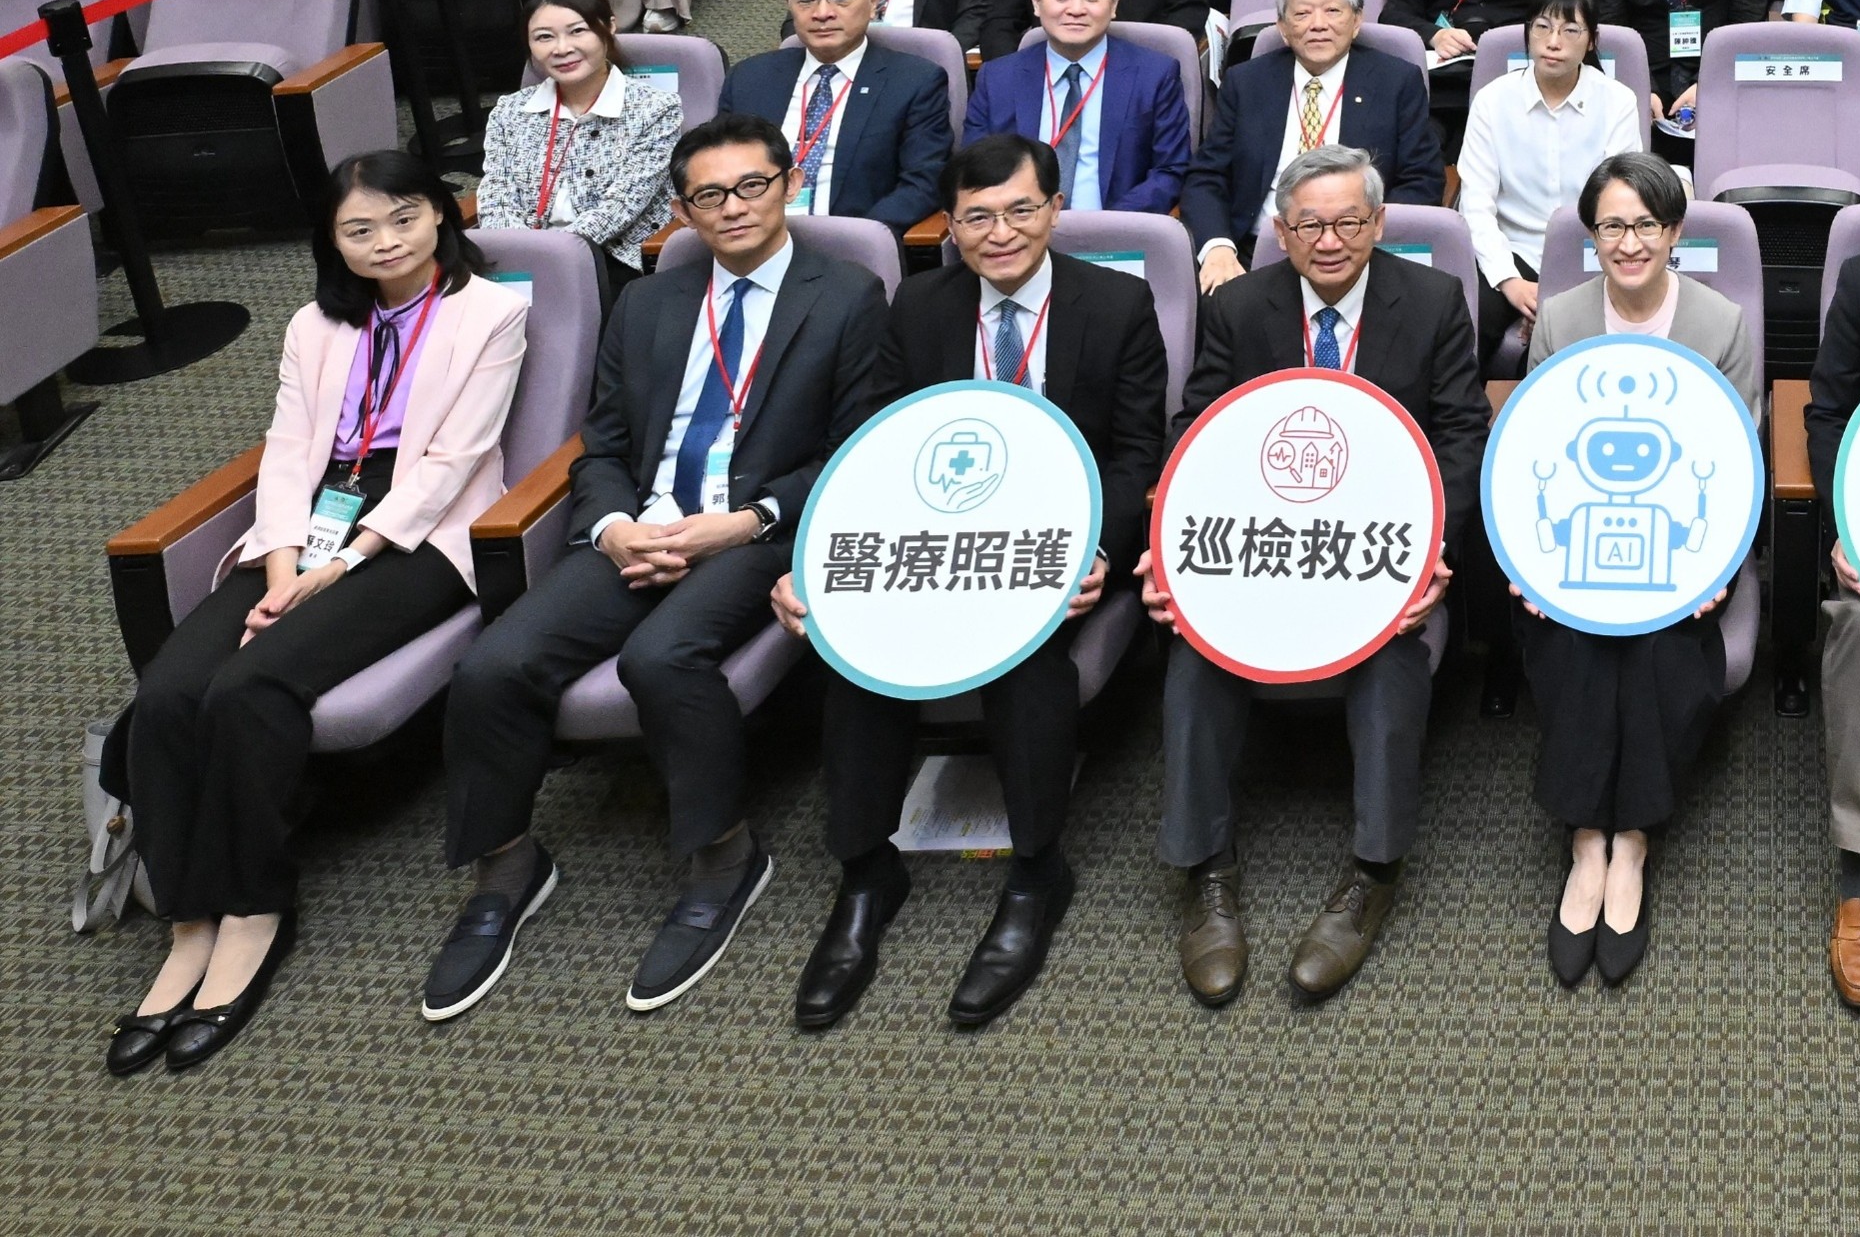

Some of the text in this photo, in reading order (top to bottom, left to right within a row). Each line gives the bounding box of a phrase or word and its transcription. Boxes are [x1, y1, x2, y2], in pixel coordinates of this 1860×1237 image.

[1766, 65, 1811, 76] 安全席
[822, 527, 1074, 596] 醫療照護
[1176, 515, 1414, 586] 巡檢救災
[1607, 541, 1633, 562] AI
